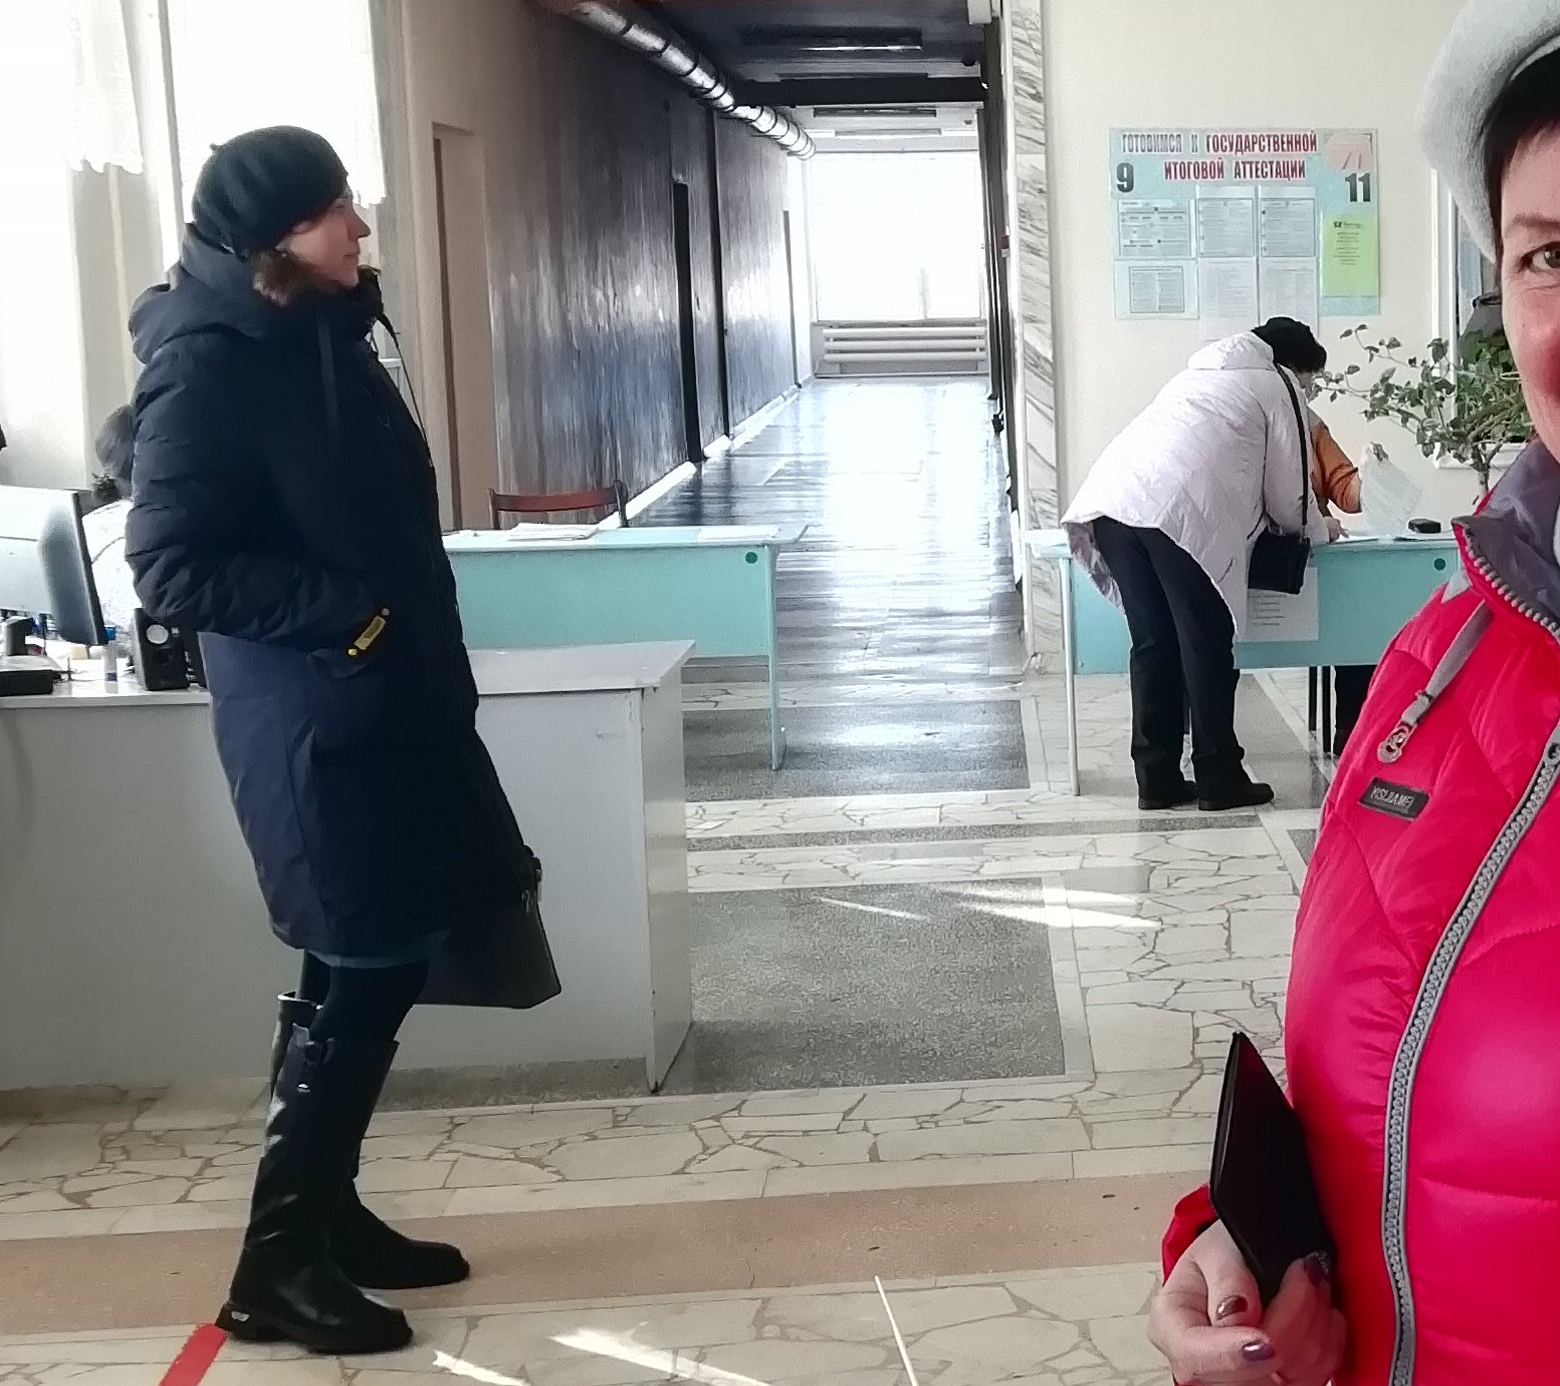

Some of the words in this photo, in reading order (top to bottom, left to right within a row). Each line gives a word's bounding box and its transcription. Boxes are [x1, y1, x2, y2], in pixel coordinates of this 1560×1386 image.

[1122, 133, 1182, 153] ГОТОВИМСЯ
[1206, 129, 1317, 155] ГОСУДАРСТВЕННОЙ
[1116, 162, 1134, 193] 9
[1164, 157, 1225, 180] ИТОГОВОЙ
[1234, 159, 1306, 181] АТТЕСТАЦИИ
[1344, 172, 1371, 203] 11
